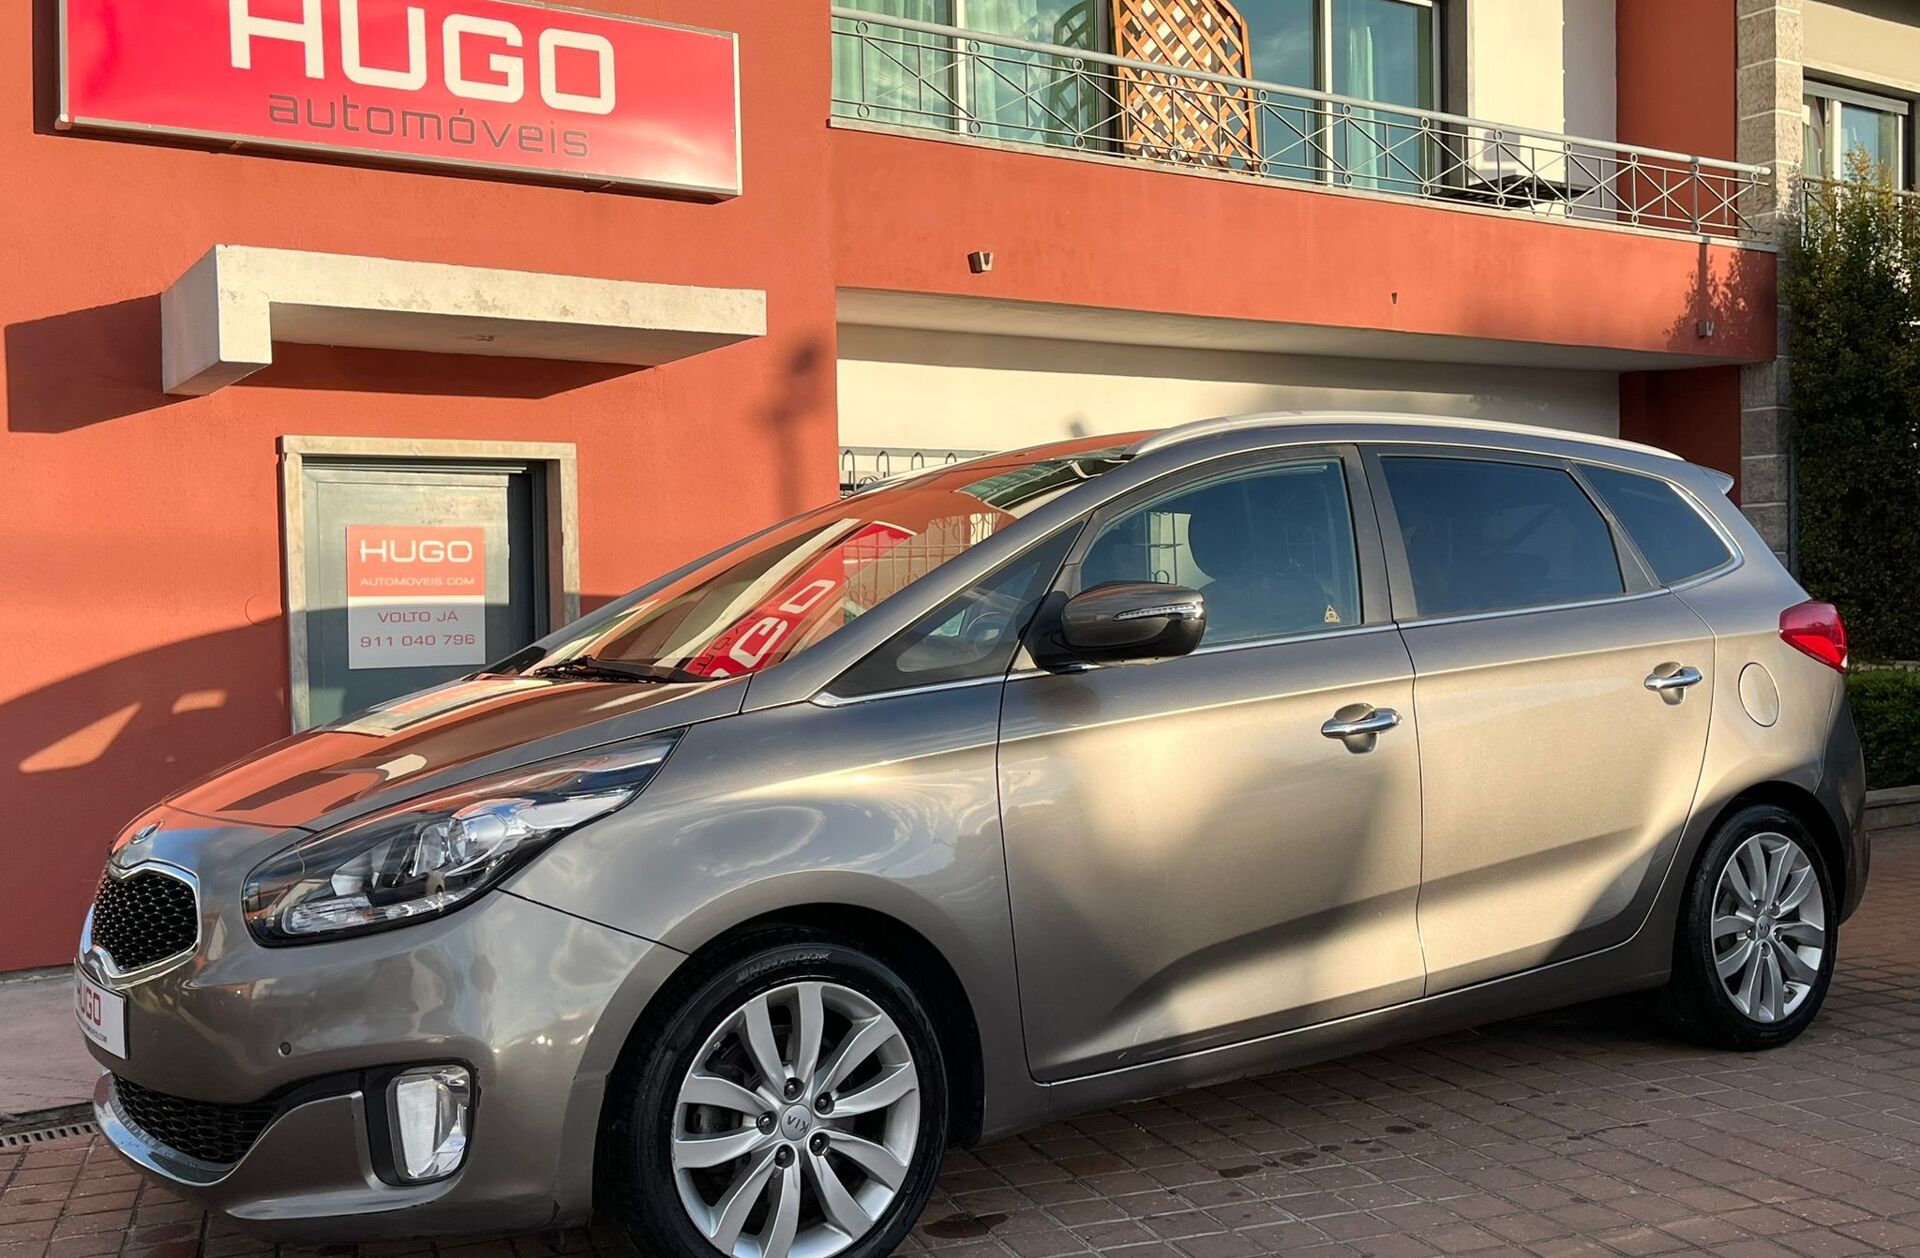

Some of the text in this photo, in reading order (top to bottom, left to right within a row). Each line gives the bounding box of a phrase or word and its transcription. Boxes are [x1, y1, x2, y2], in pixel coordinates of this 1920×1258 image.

[229, 0, 616, 115] HUGO
[268, 93, 590, 158] automóveis
[360, 539, 473, 563] HUGO
[377, 608, 459, 623] VOLTO JÁ
[360, 633, 476, 648] 911 040 796
[787, 1115, 810, 1133] KIA
